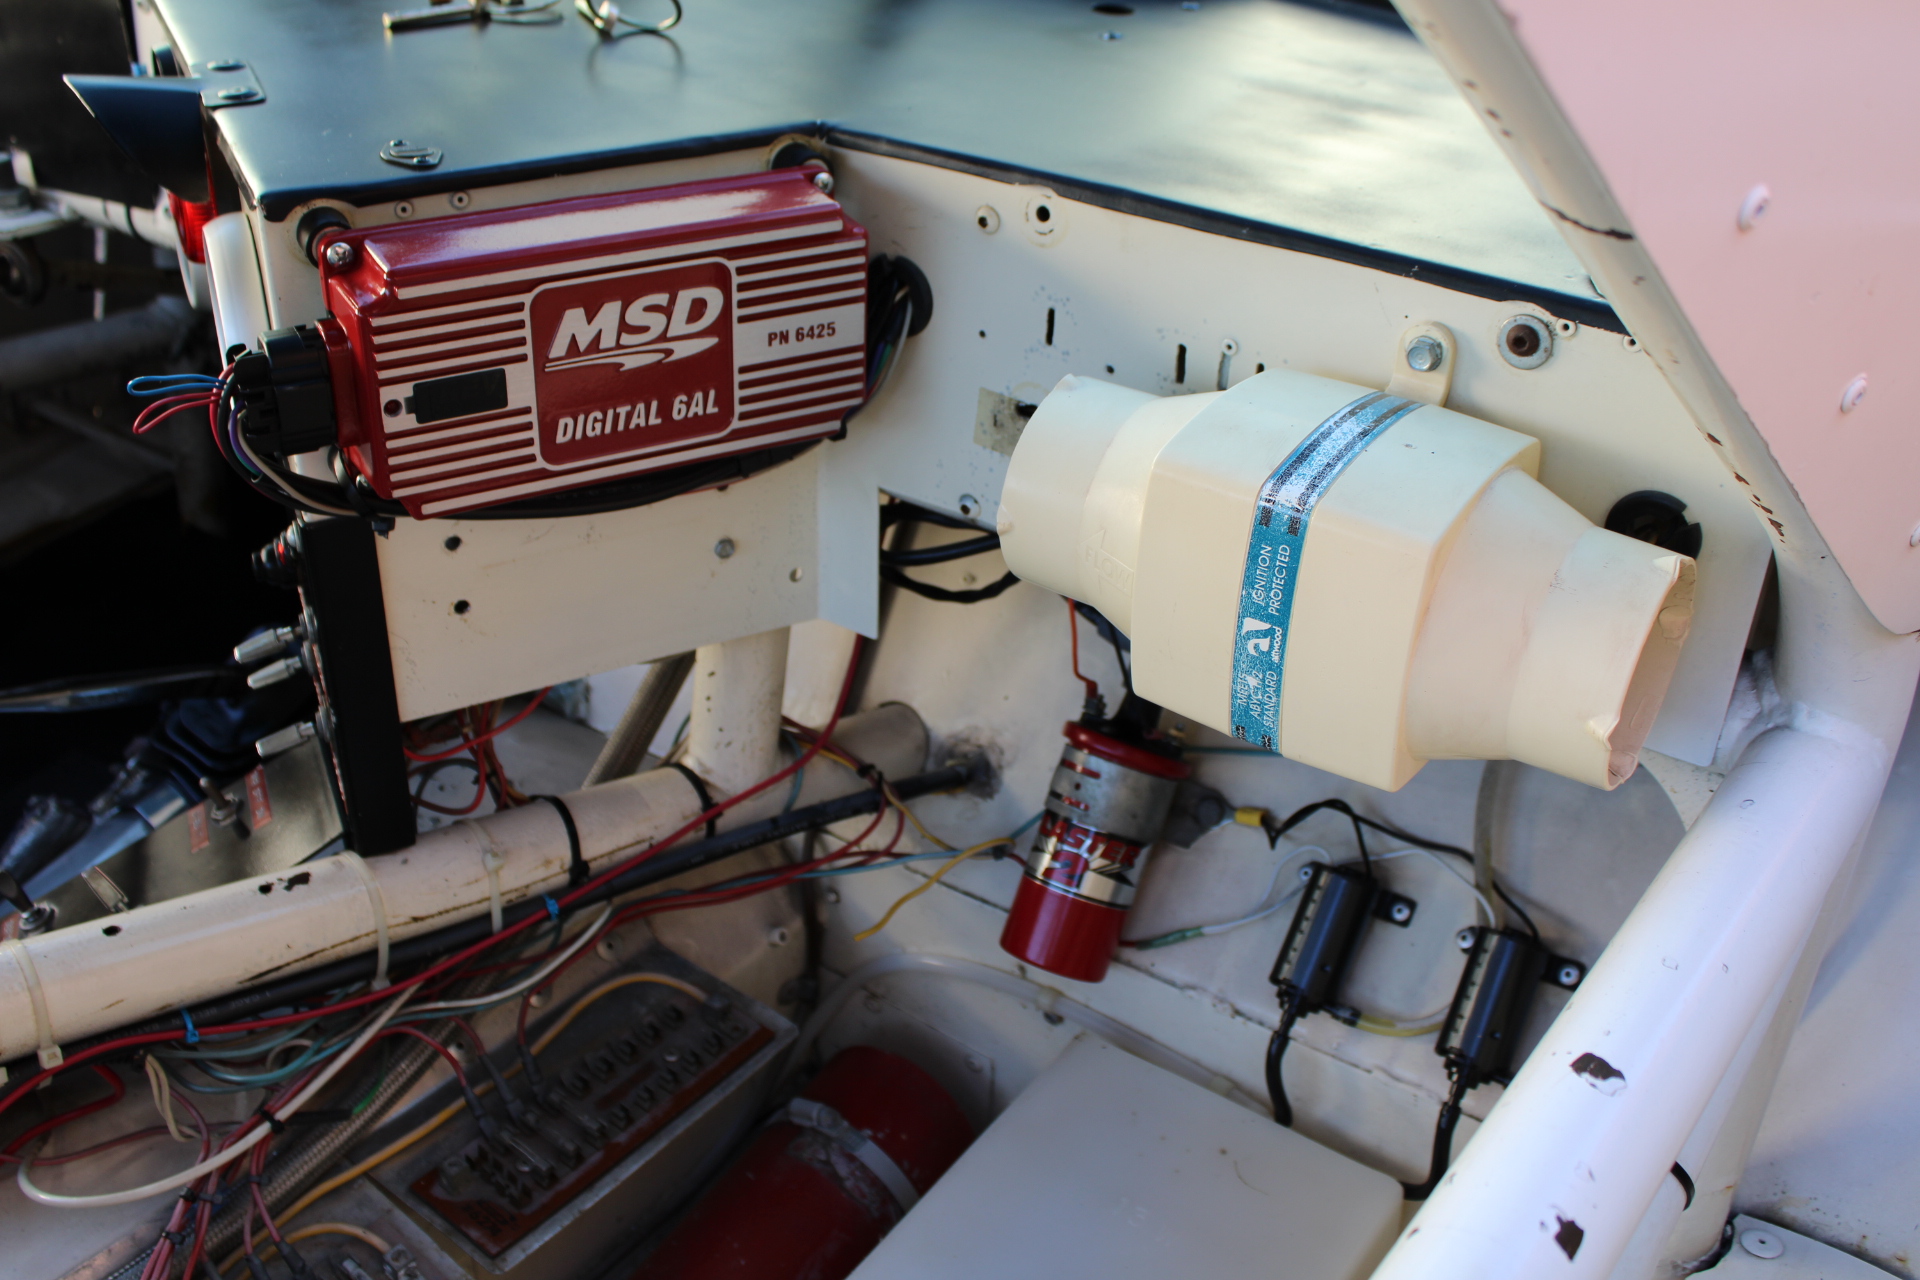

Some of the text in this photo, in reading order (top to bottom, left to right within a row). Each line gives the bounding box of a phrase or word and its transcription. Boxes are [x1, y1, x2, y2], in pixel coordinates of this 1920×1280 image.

[548, 286, 725, 360] MSD
[767, 322, 836, 347] PN 6425
[555, 389, 719, 444] DIGITAL 6AL
[1252, 544, 1272, 606] IGNITION
[1268, 545, 1290, 615] PROTECTED
[1272, 625, 1283, 664] attwood
[1249, 690, 1263, 720] ABYC
[1263, 671, 1277, 728] STANDARD
[1039, 811, 1142, 868] LASTER
[1042, 850, 1089, 888] 2
